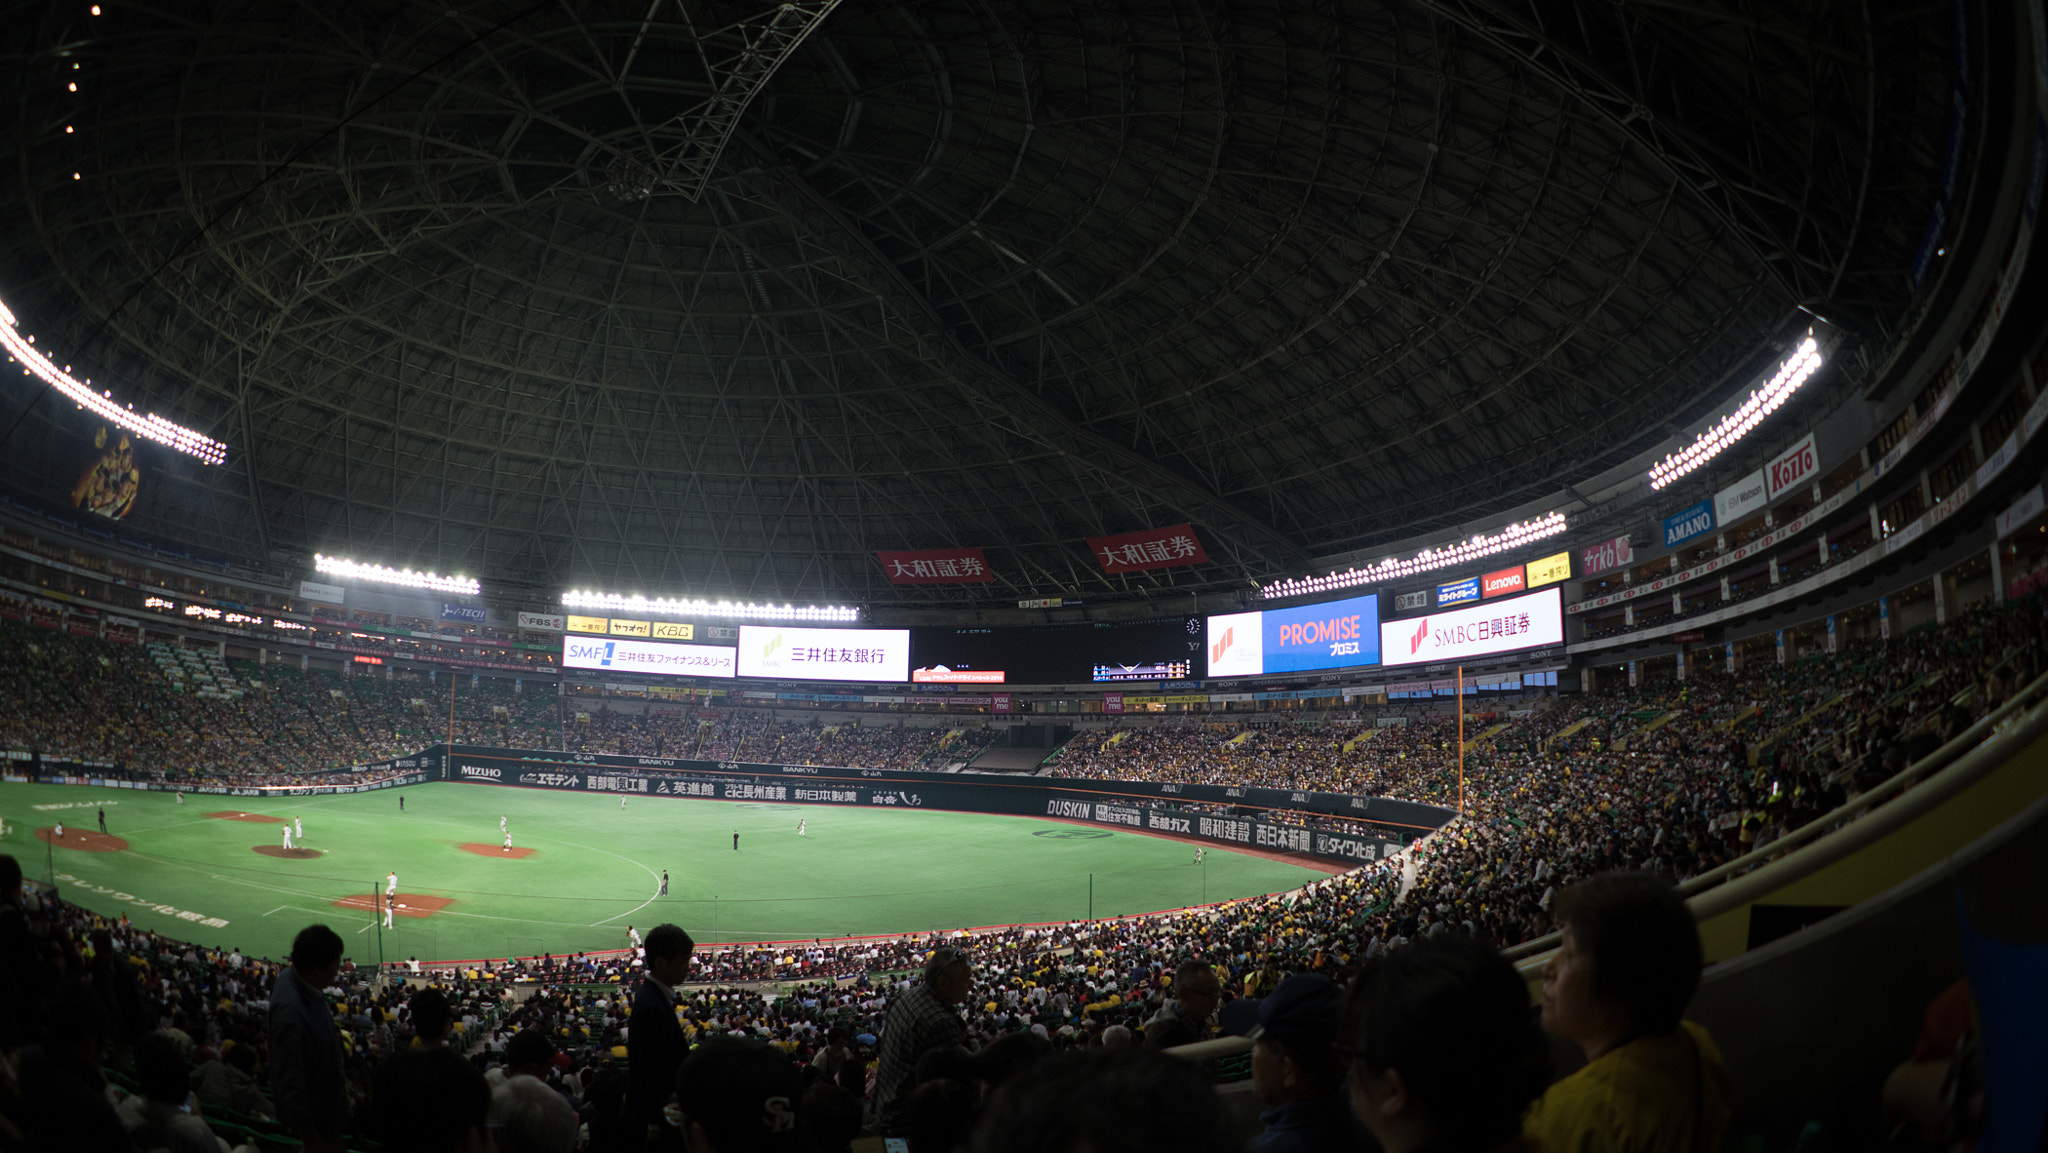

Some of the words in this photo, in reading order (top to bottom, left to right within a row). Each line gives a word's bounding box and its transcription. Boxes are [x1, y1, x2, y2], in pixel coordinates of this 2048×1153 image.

[1740, 486, 1762, 503] Watson
[1667, 512, 1711, 545] AMANO
[1098, 535, 1196, 567] 大和証券
[888, 557, 984, 579] 大和証券
[1485, 574, 1522, 591] Lenovo
[1406, 592, 1425, 606] 禁煙
[529, 616, 551, 626] FBS
[614, 623, 647, 634] ヤフオク!
[656, 625, 689, 637] KBC
[1280, 615, 1360, 647] PROMISE
[1434, 612, 1530, 647] SMBC日興証券
[791, 647, 885, 664] 三井住友銀行
[1329, 642, 1360, 657] プロミス
[1530, 650, 1553, 660] SONY
[618, 651, 731, 668] 三井住友ファイナンス&リース
[1425, 664, 1446, 672] SONY
[1321, 674, 1343, 682] SONY
[994, 697, 1008, 705] you
[1106, 696, 1120, 705] you
[1108, 702, 1121, 710] me
[461, 765, 501, 777] MIZUHO
[587, 775, 648, 793] 西部電気工業
[673, 781, 715, 796] 英進館
[1161, 784, 1176, 793] ANA
[743, 785, 787, 800] 長州産業
[794, 788, 857, 803] 新日本製薬
[1226, 788, 1240, 797] ANA
[1290, 792, 1305, 802] ANA
[1046, 799, 1091, 819] DUSKIN
[1350, 798, 1364, 809] ANA
[1107, 812, 1141, 826] 住友不動産
[1149, 815, 1191, 834] 西部ガス
[1200, 817, 1250, 843] 昭和建設
[1256, 824, 1310, 853] 西日本新聞
[1328, 839, 1376, 860] ダイワ化成
